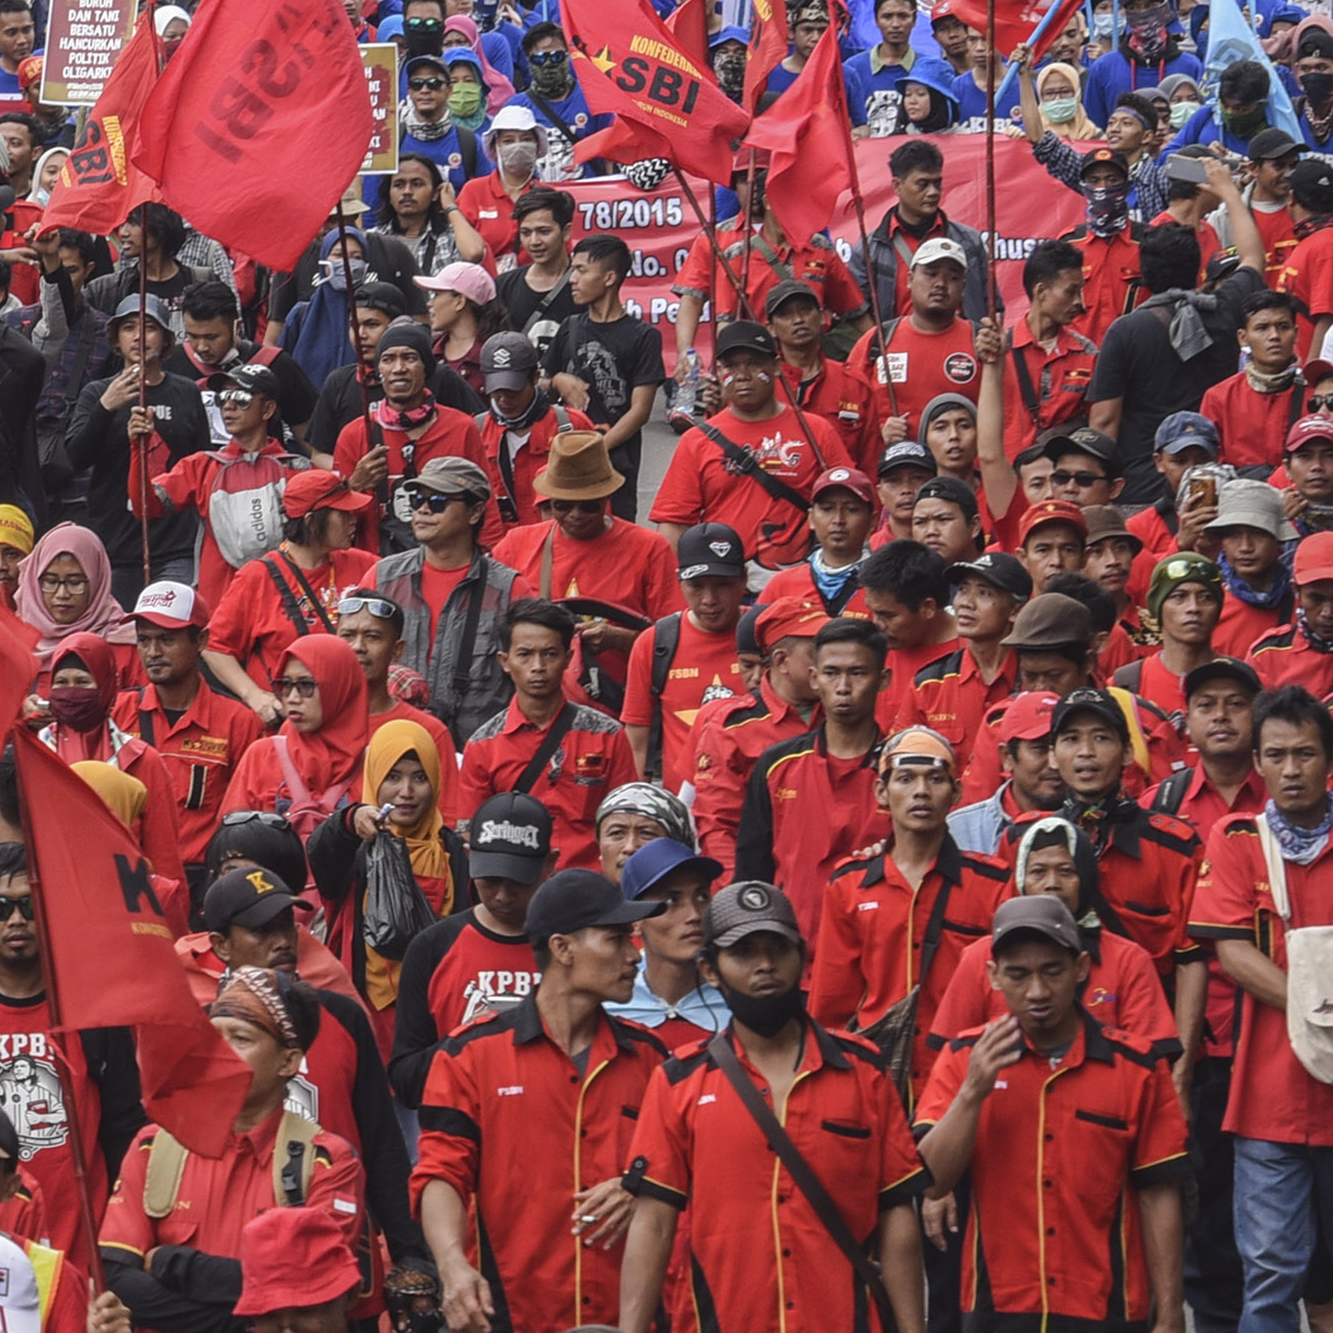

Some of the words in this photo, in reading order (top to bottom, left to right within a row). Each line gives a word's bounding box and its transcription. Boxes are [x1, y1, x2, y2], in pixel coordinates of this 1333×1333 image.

[68, 10, 92, 22] DAN
[94, 10, 119, 22] TANI
[70, 24, 116, 37] BERSATU
[59, 37, 121, 51] HANCURKAN
[69, 53, 110, 65] POLITIK
[579, 198, 683, 229] 78/2015
[251, 498, 267, 542] adidas
[669, 668, 699, 680] FSBN
[246, 871, 274, 894] K
